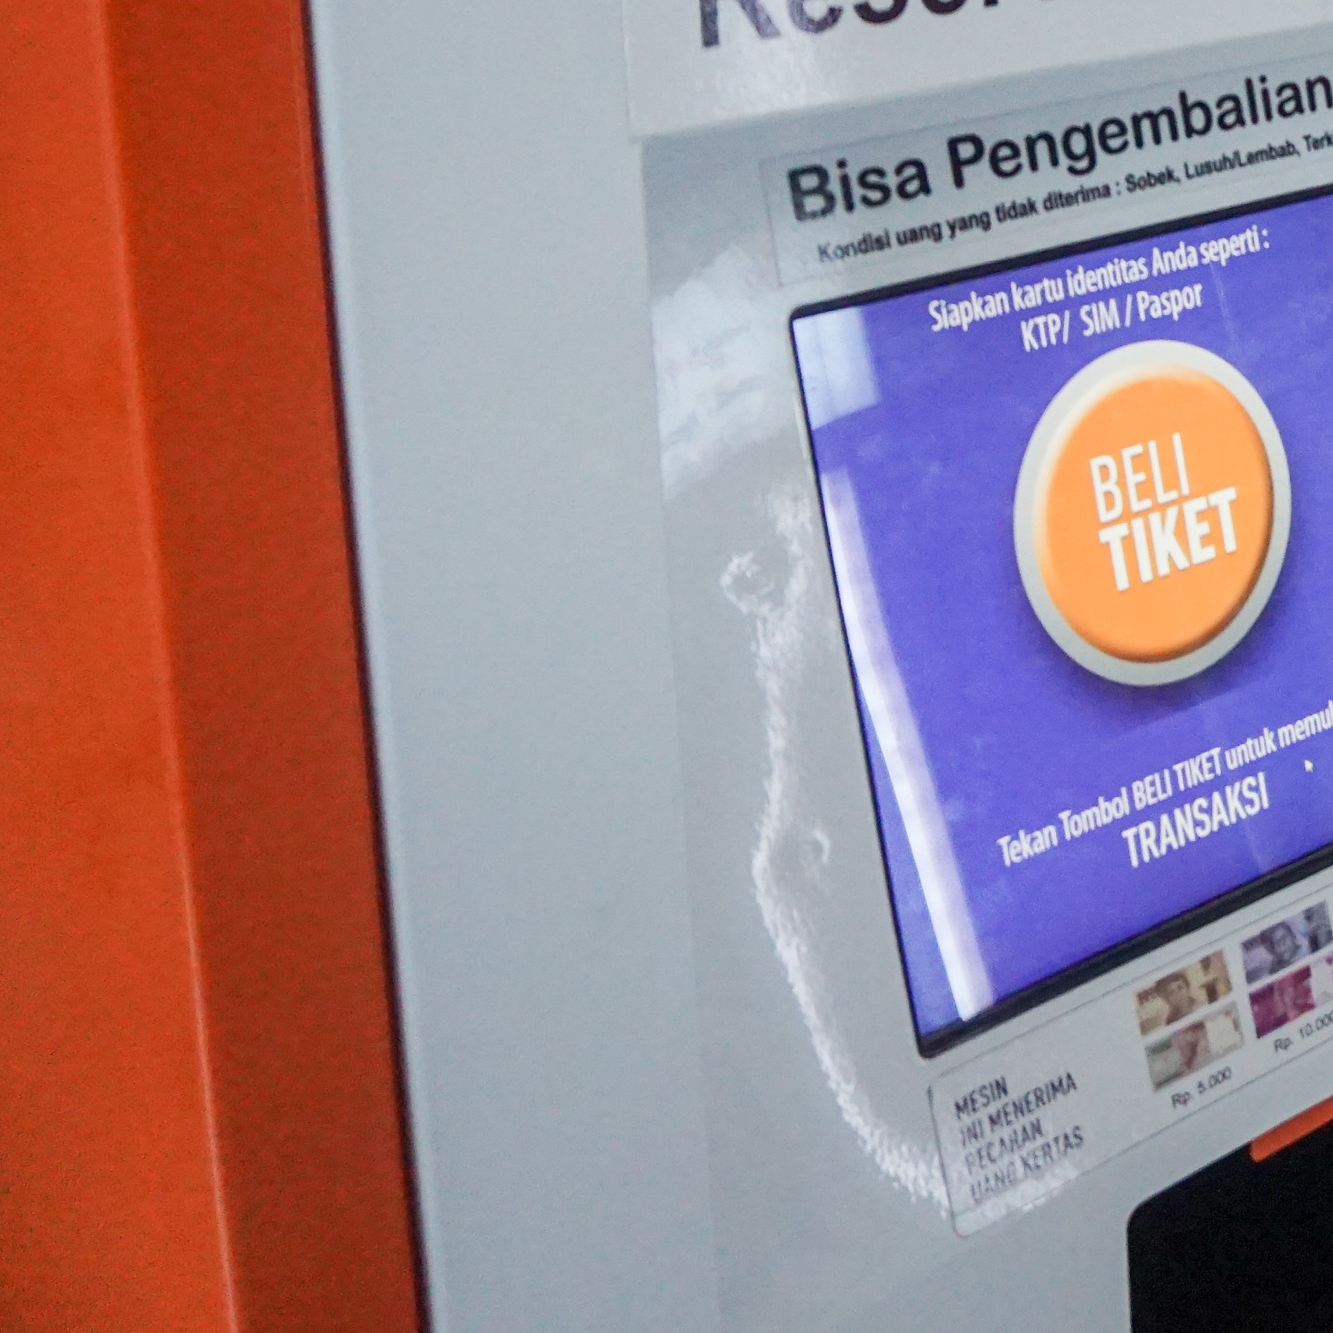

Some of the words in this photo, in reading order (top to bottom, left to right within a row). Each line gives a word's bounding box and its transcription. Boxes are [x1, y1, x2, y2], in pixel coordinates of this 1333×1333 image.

[787, 157, 932, 222] Bisa
[946, 74, 1333, 189] Pengembalian
[818, 223, 891, 263] Kondisi
[896, 220, 942, 247] uang
[946, 210, 992, 239] yang
[995, 195, 1037, 223] tidak
[1043, 179, 1112, 212] diterima
[1124, 166, 1180, 193] Sobek,
[928, 289, 1009, 333] Siapkan
[1011, 277, 1063, 315] kartu
[1066, 253, 1148, 298] identitas
[1150, 242, 1198, 277] Anda
[1200, 224, 1260, 266] seperti
[1020, 314, 1071, 353] KTP/
[1081, 301, 1120, 337] SIM
[1136, 281, 1203, 327] Paspor
[1088, 432, 1190, 524] BELI
[1098, 486, 1239, 592] TIKET
[996, 824, 1057, 867] Tekan
[1058, 786, 1130, 841] Tombol
[1132, 769, 1172, 812] BELI
[1173, 747, 1223, 792] TIKET
[1225, 727, 1278, 771] untuk
[1121, 772, 1271, 868] TRANSAKSI
[954, 1075, 1009, 1121] MESIN
[960, 1122, 984, 1147] INI
[988, 1071, 1078, 1134] MENERIMA
[1022, 1125, 1084, 1172] KERTAS
